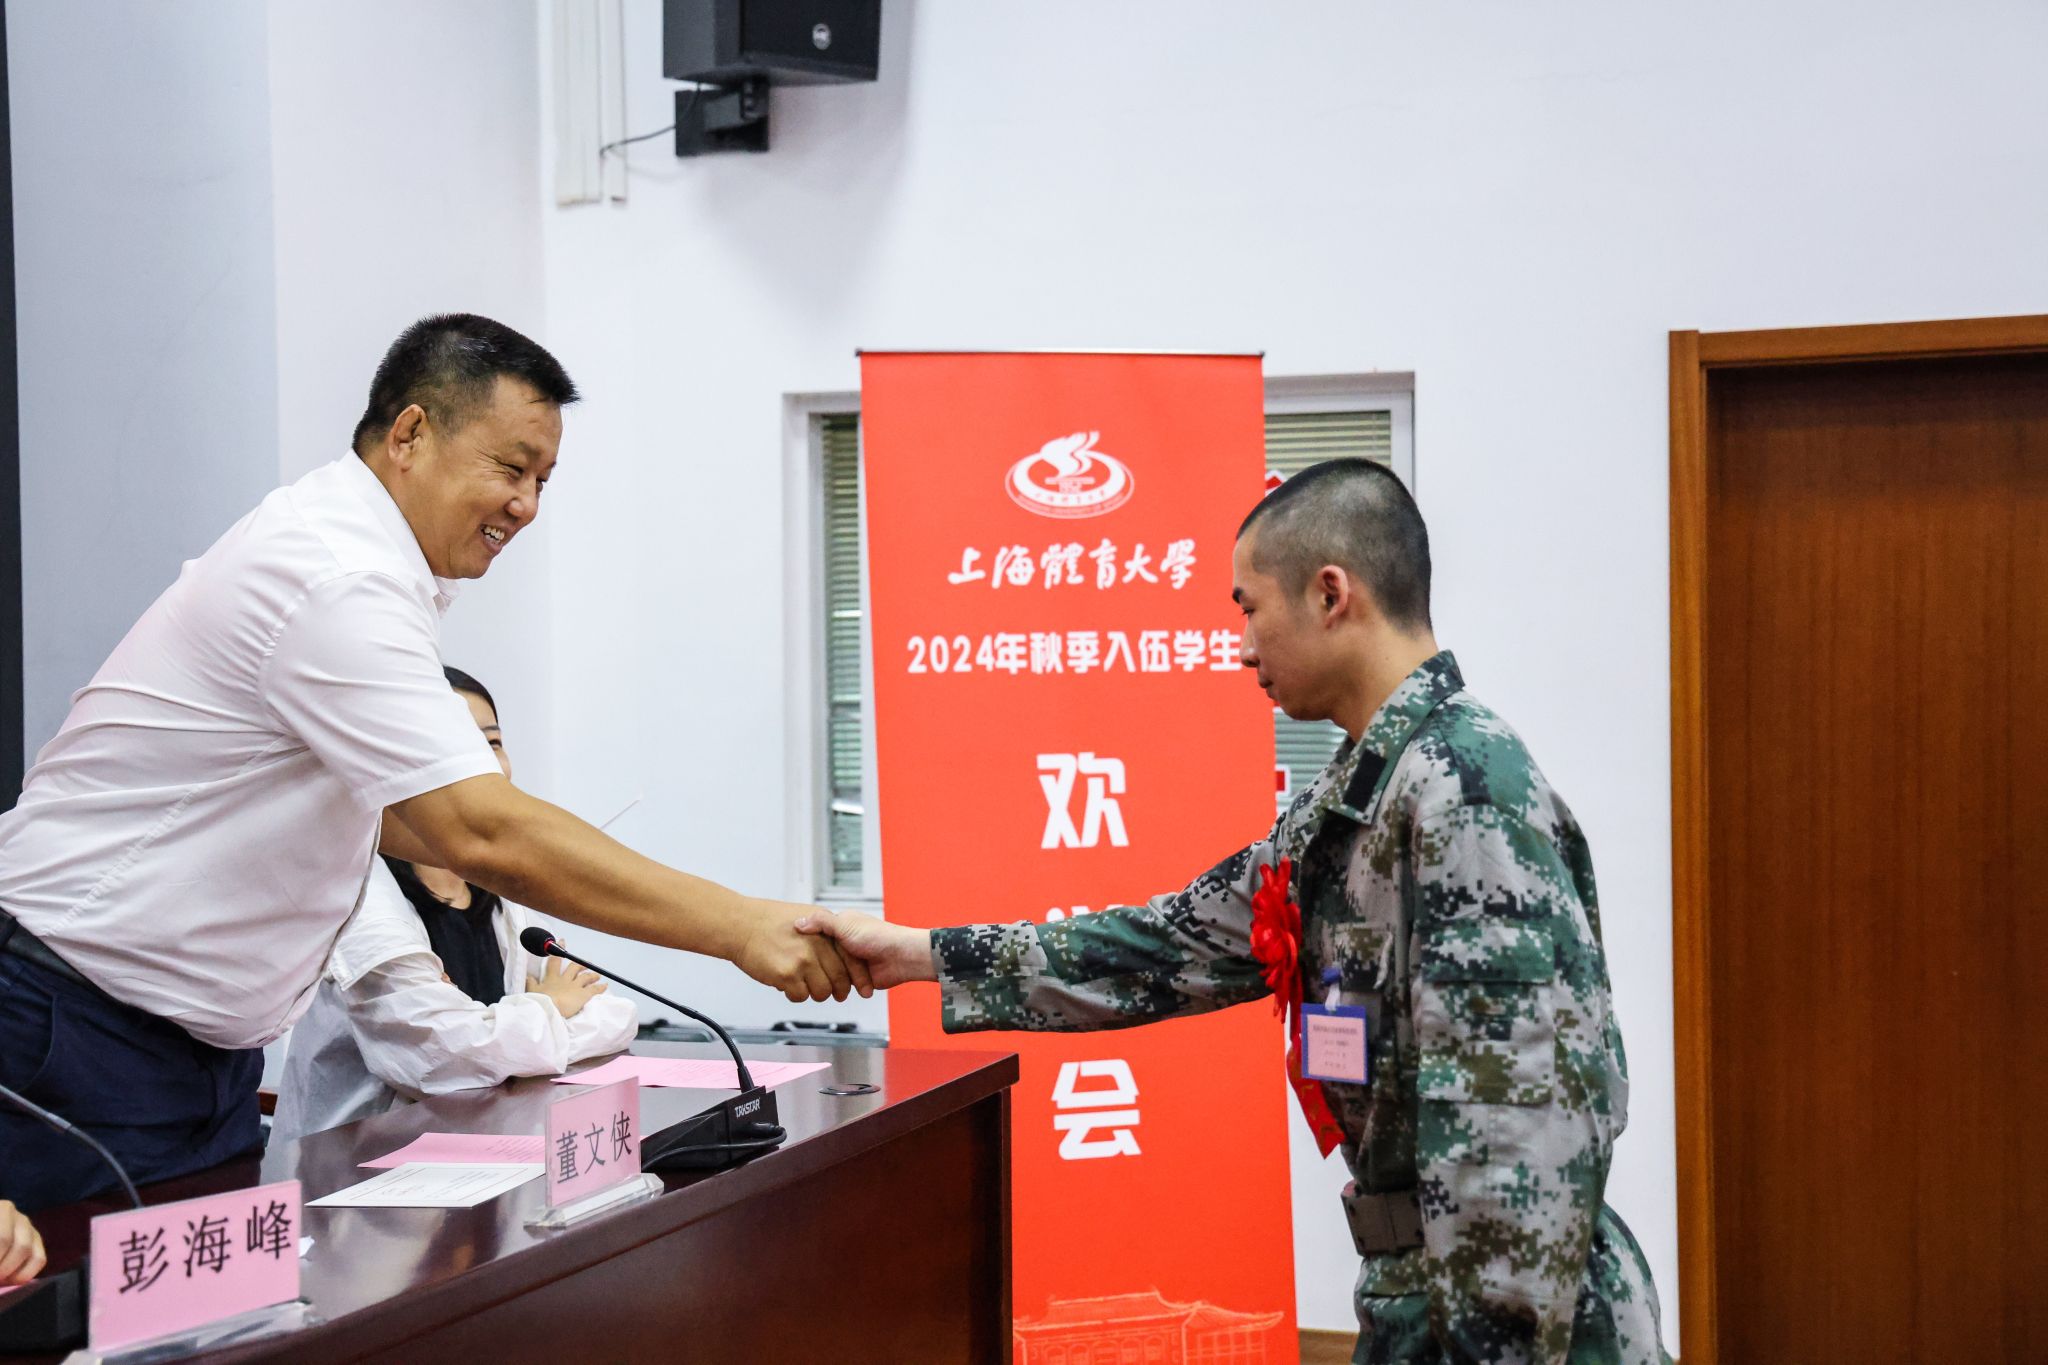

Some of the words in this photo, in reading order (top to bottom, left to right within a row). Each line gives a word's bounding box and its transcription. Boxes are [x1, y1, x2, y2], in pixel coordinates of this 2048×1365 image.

[947, 538, 1197, 590] 上海體育大學
[907, 629, 1243, 675] 2024年秋季入伍学生
[734, 1098, 761, 1118] TAKSTAR
[556, 1110, 633, 1184] 董文侠
[119, 1200, 292, 1294] 彭海峰
